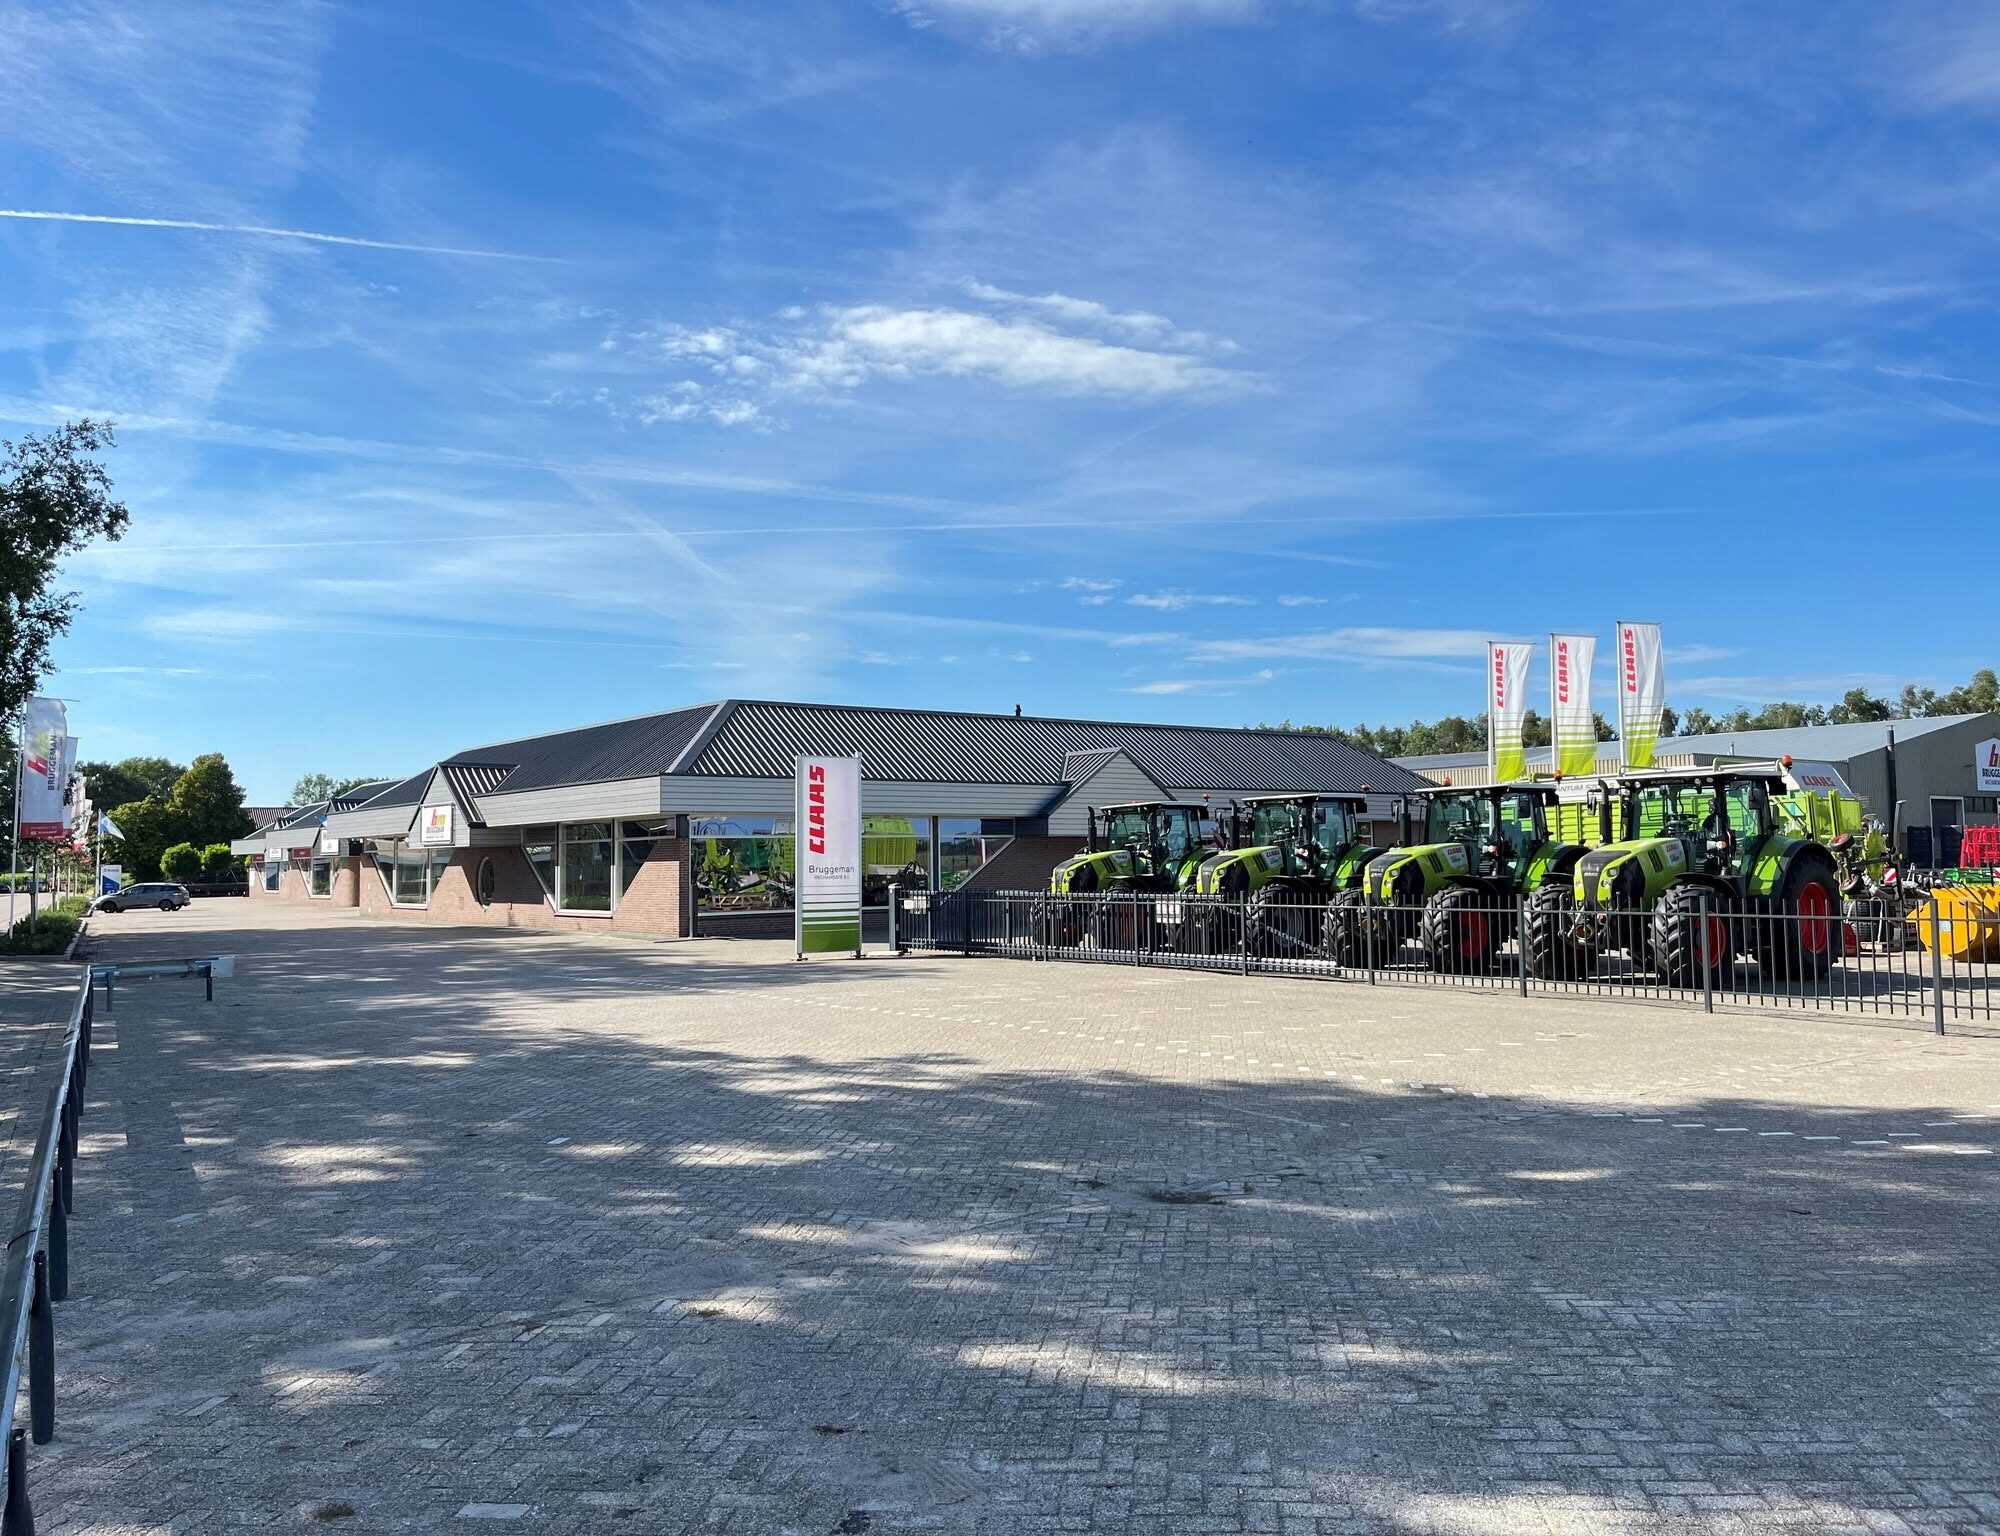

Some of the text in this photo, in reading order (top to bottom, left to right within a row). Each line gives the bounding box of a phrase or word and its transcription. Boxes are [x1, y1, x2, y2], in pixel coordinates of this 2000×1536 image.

[1495, 648, 1504, 708] CLAAS
[1558, 641, 1568, 703] CLAAS
[1624, 628, 1637, 693] CLAAS
[47, 735, 57, 791] BRUGGEMAN
[1801, 775, 1836, 787] CLAAS
[809, 765, 825, 855] CLAAS
[808, 865, 855, 875] Bruggeman
